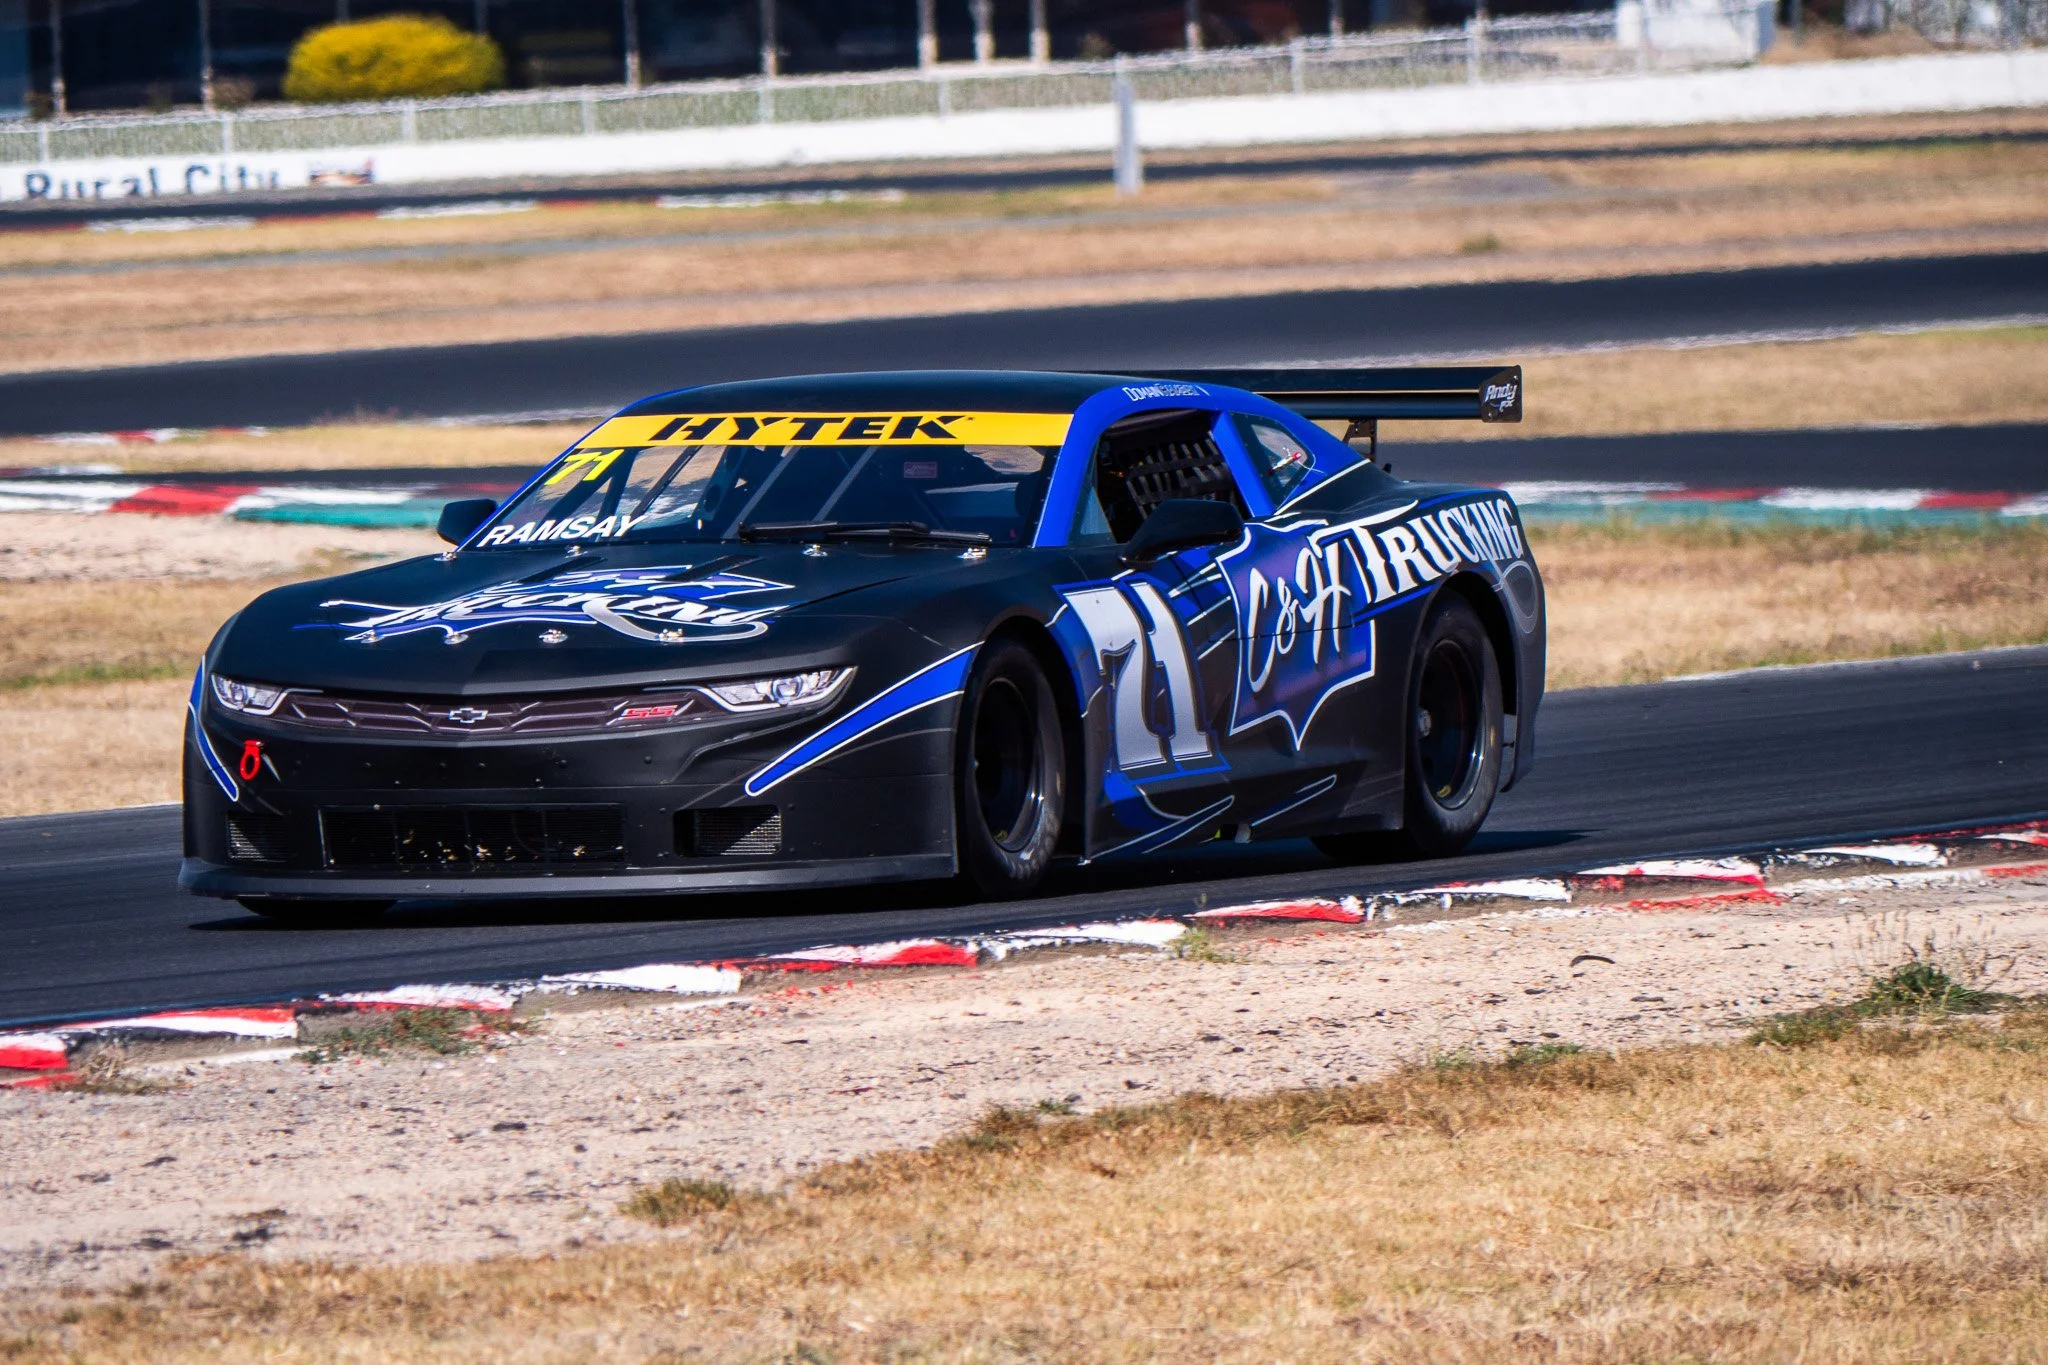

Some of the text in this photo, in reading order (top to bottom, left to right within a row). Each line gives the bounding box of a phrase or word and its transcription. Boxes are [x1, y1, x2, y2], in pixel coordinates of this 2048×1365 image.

[26, 167, 158, 199] Rural
[1484, 383, 1518, 402] Andy
[648, 415, 966, 441] HYTEK
[544, 449, 625, 486] 71
[476, 515, 650, 548] RAMSAY
[1308, 498, 1524, 604] TRUCKING
[1062, 581, 1213, 771] 71
[617, 705, 679, 720] SS
